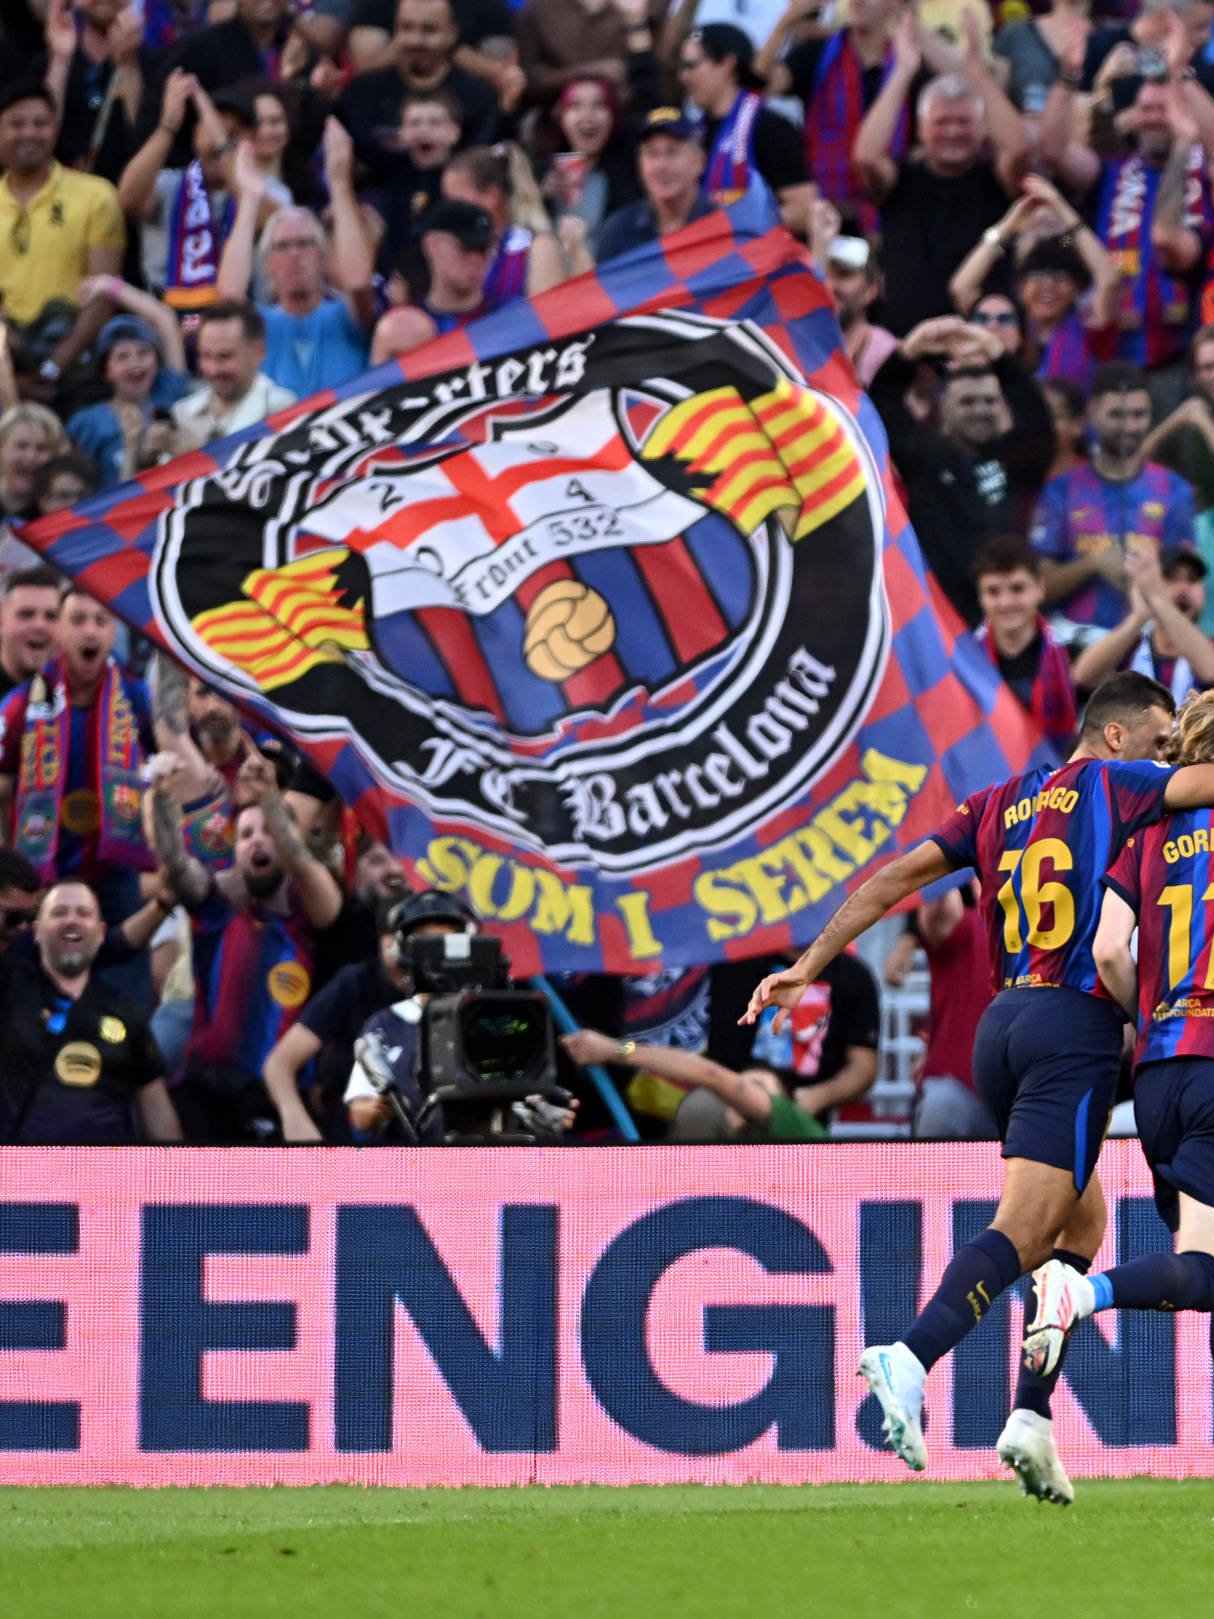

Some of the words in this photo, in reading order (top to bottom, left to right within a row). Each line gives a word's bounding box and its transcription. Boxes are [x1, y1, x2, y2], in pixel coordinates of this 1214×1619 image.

[548, 509, 625, 546] 532
[554, 645, 837, 842] Barcelona
[414, 835, 596, 946] SOM
[615, 891, 664, 960] I
[693, 747, 929, 943] SEREM
[997, 837, 1076, 954] 16
